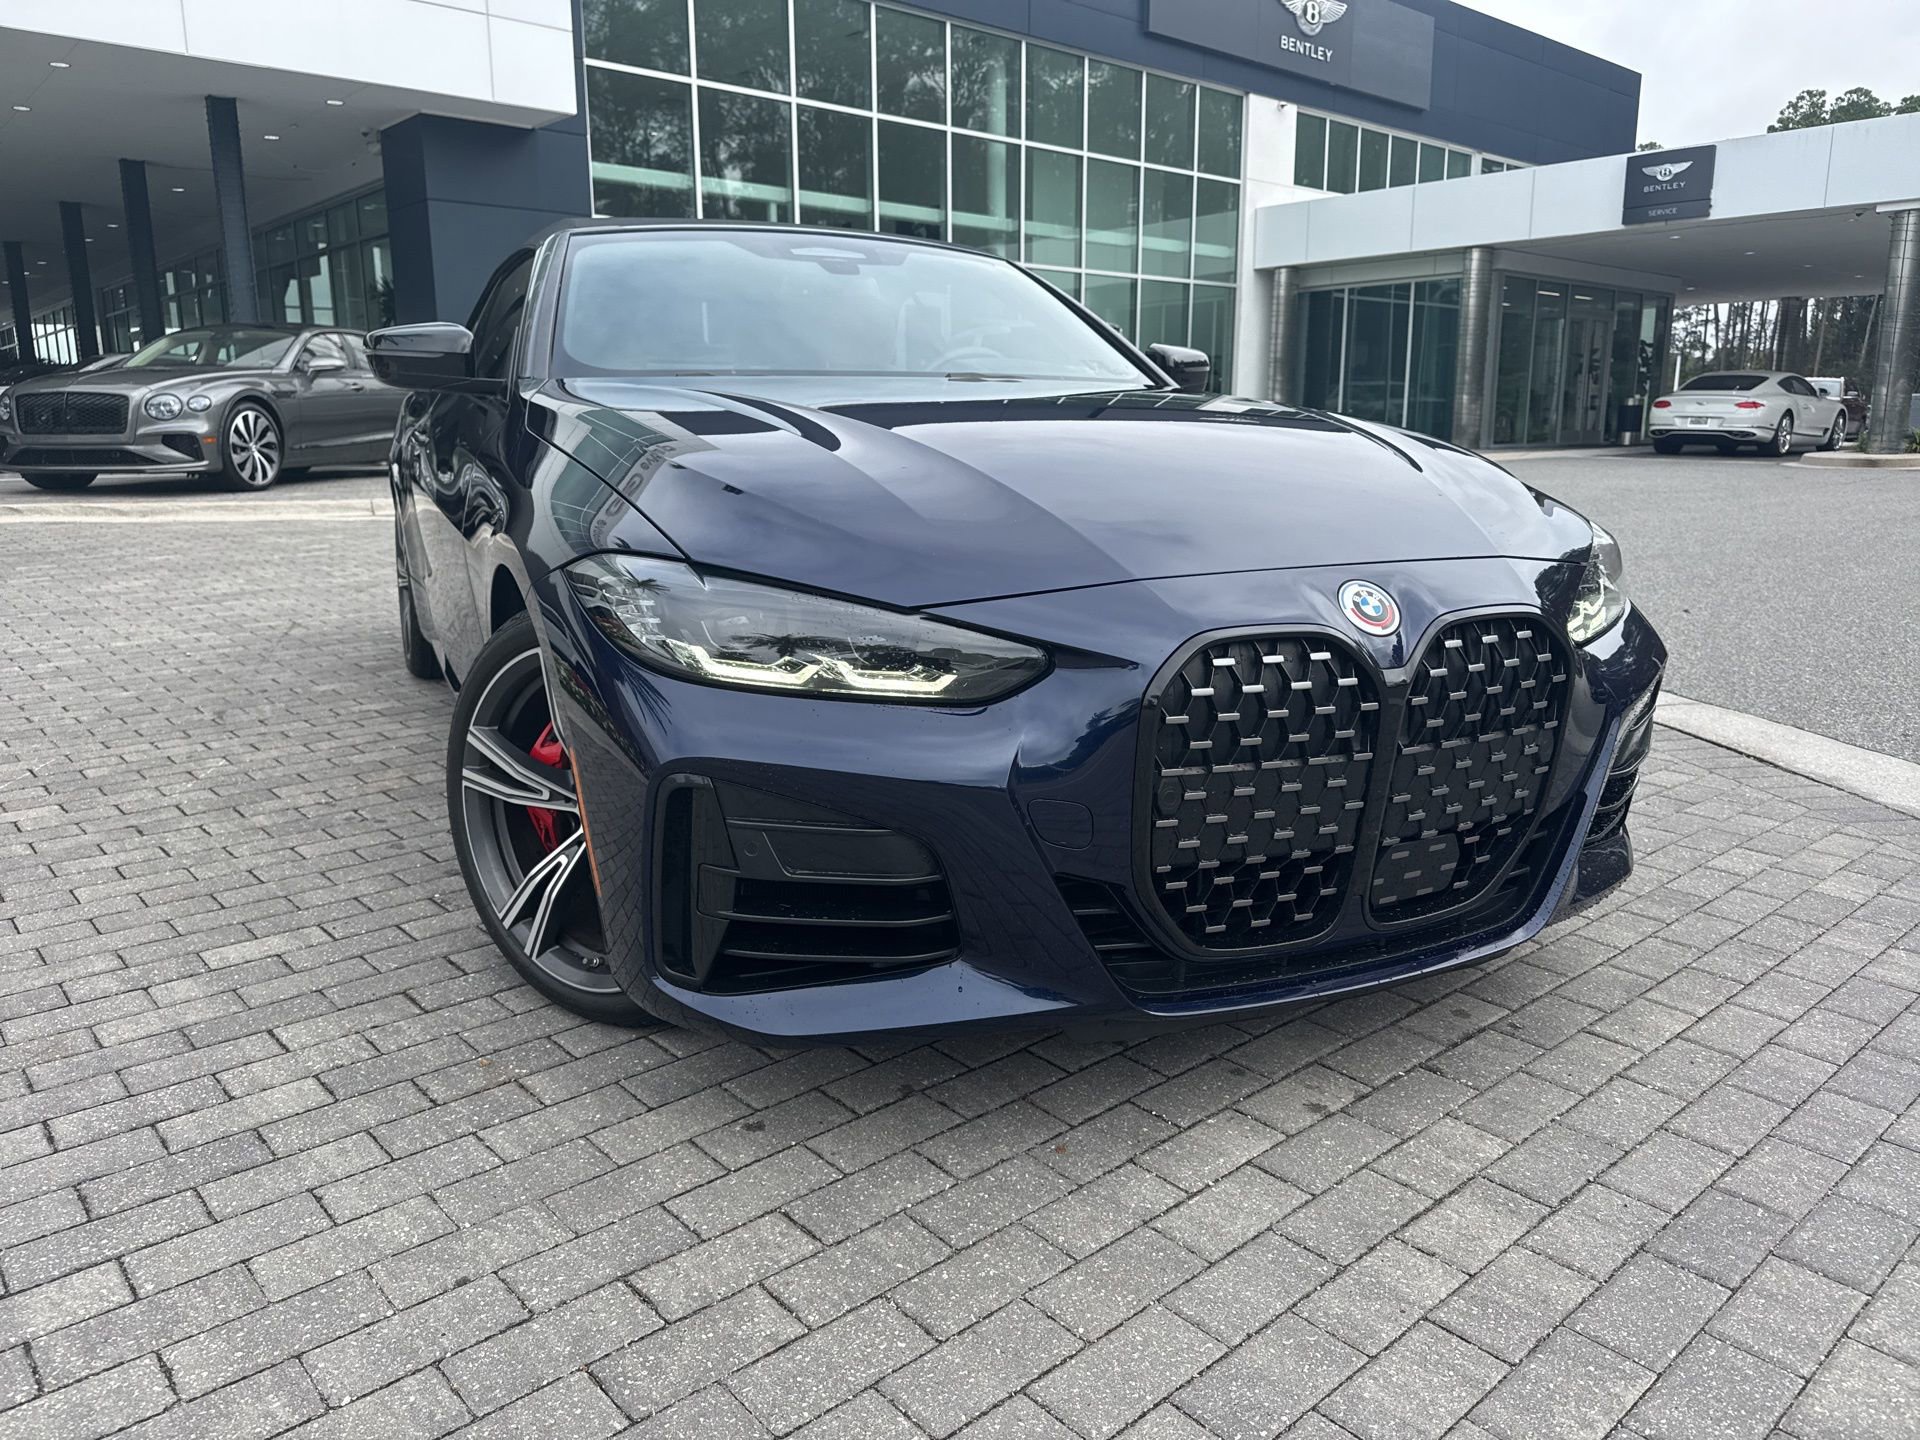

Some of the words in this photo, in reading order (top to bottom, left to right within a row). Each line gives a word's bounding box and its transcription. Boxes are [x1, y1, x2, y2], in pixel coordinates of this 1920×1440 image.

[1280, 35, 1333, 62] BENTLEY
[1643, 181, 1686, 193] BENTLEY
[1648, 207, 1678, 216] SERVICE
